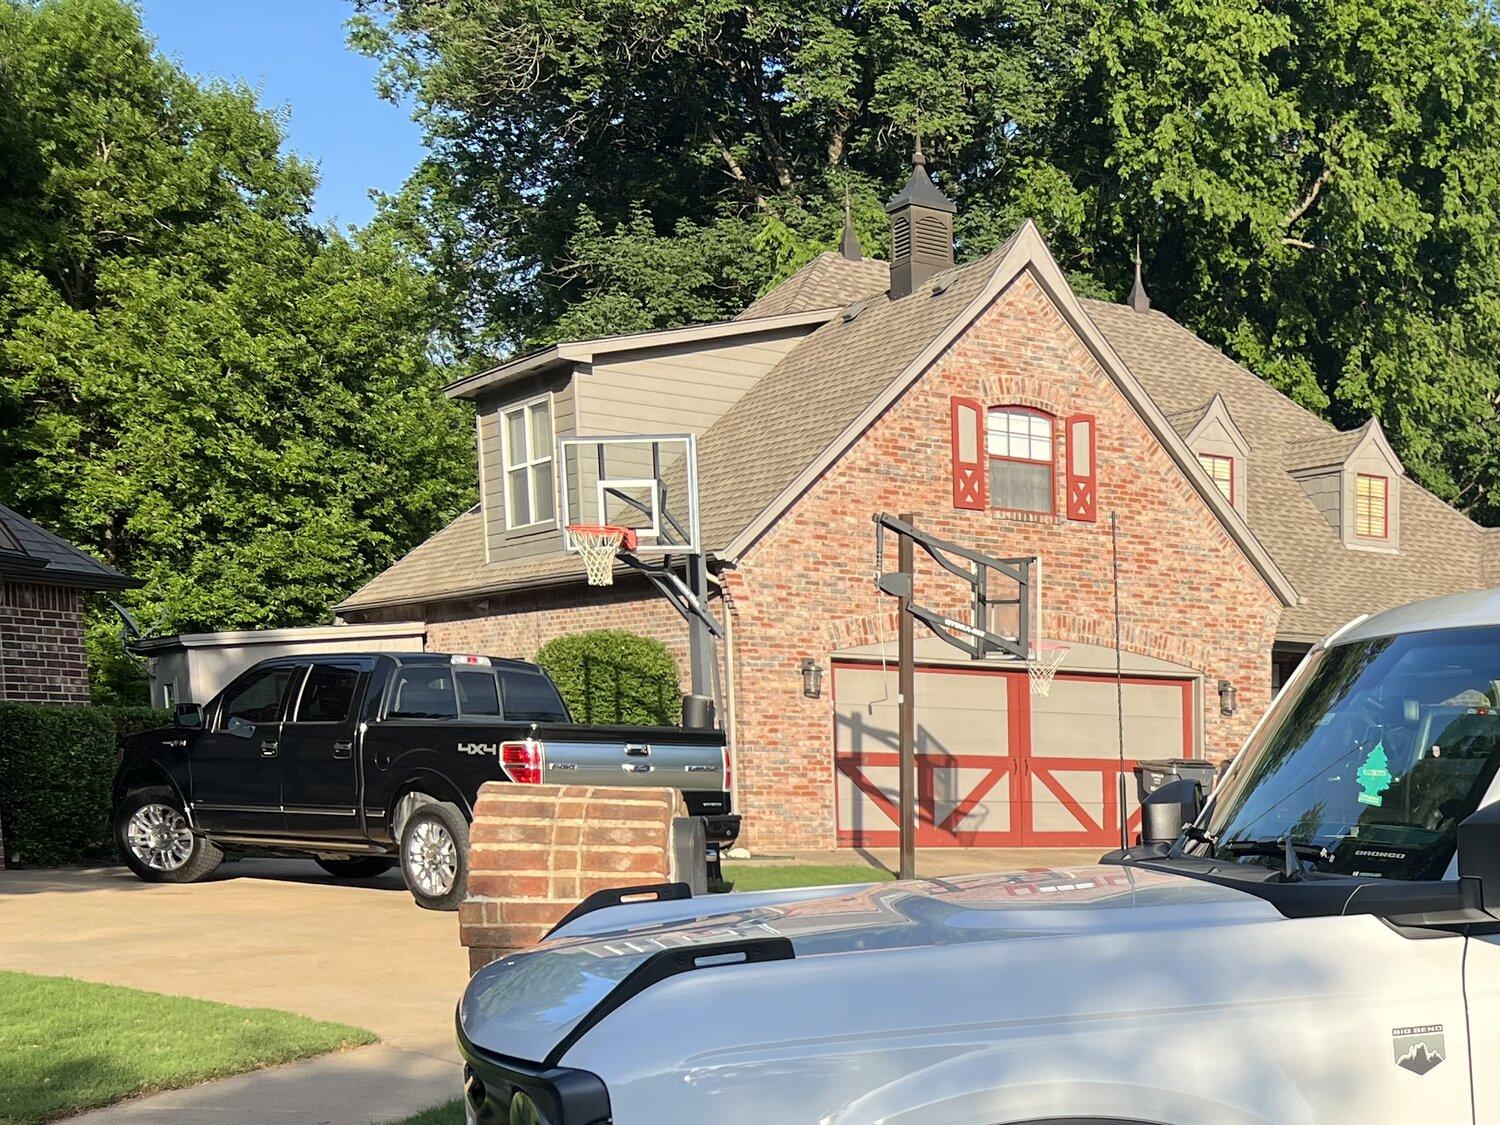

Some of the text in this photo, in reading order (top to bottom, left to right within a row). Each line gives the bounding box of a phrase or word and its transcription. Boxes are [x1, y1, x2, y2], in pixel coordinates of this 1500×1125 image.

[1354, 850, 1406, 859] BRONCO
[1393, 1025, 1442, 1036] BIG BEND
